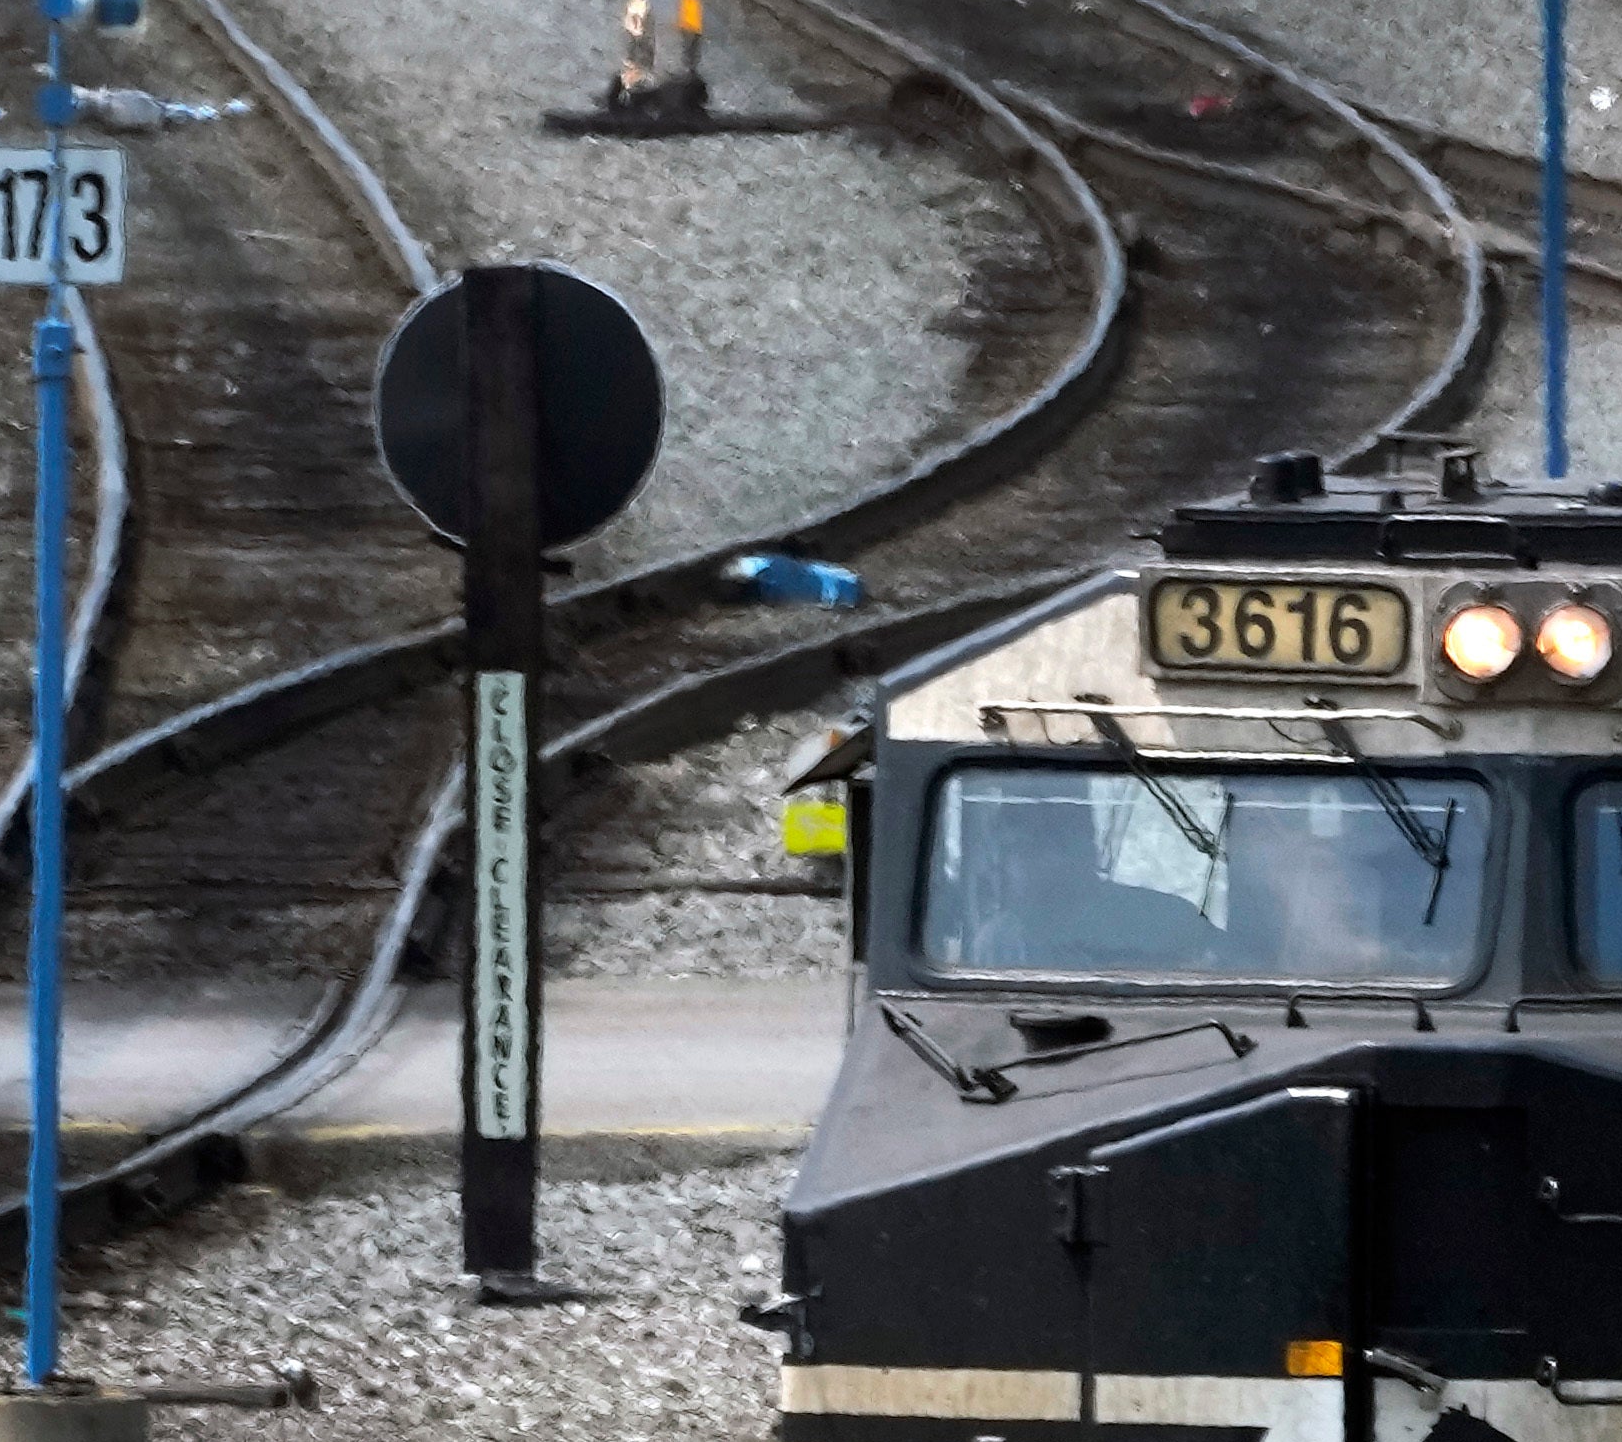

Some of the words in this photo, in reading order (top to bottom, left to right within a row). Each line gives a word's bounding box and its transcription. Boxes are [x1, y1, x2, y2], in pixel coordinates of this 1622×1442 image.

[1178, 586, 1372, 665] 3616
[488, 676, 518, 834] CLOSE
[489, 858, 514, 1120] CLEARANCE
